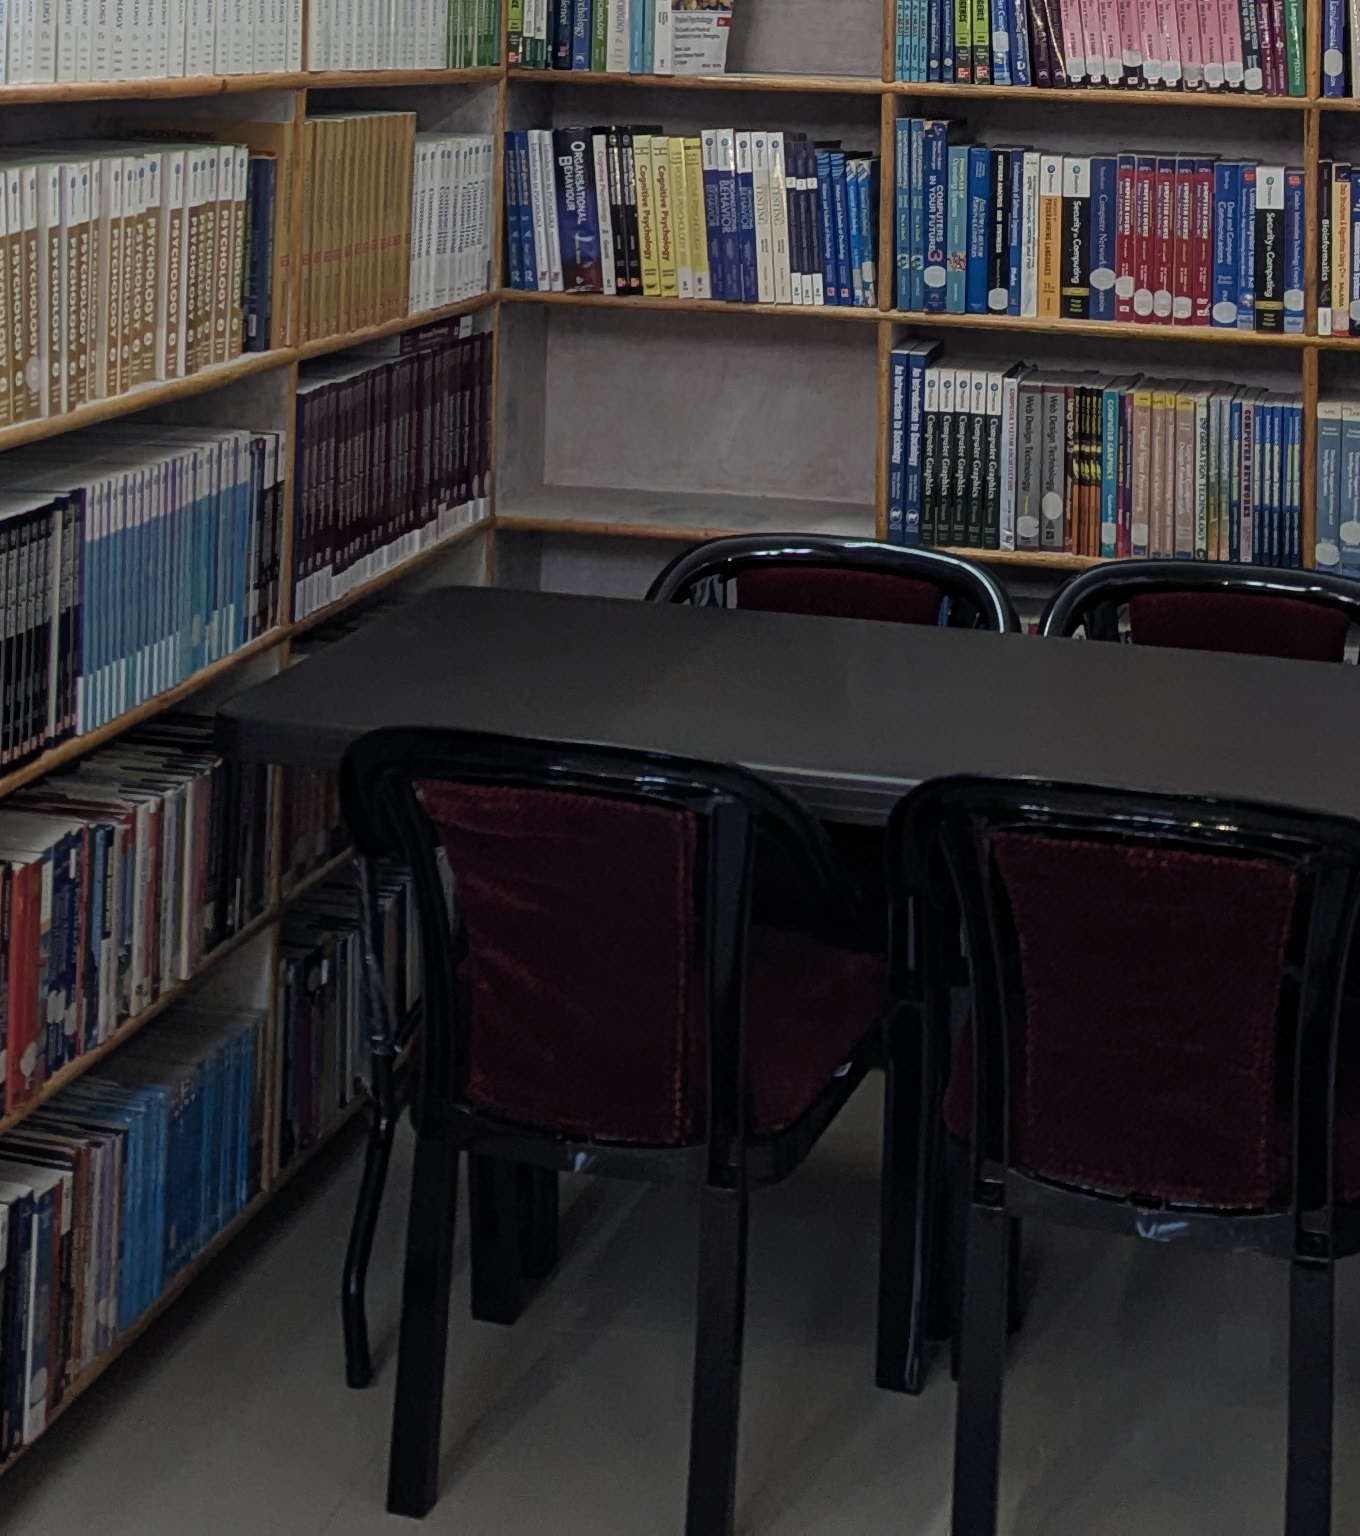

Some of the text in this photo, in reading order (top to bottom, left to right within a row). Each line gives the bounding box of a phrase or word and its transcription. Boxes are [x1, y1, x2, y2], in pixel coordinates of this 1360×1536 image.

[558, 156, 575, 211] BEHAVIOUR
[571, 141, 587, 224] ORGANISATIONAL
[638, 164, 657, 260] Cognitive Psychology
[657, 165, 676, 261] Cognitive Psychology
[719, 180, 732, 233] BEHAVIOR
[936, 184, 944, 242] COMPUTERS
[144, 218, 156, 323] PSYCHOLOGY
[218, 210, 229, 310] PSYCHOLOGY
[928, 214, 936, 250] FUTURE
[928, 249, 943, 262] 3
[1071, 200, 1081, 284] Security Computing
[1265, 213, 1275, 297] Security Computing
[1321, 219, 1329, 281] Bioinformatics
[923, 415, 936, 495] Computer Graphics
[986, 419, 998, 499] Computer Graphics
[1022, 446, 1033, 491] Technology
[1023, 416, 1033, 443] Design
[1046, 396, 1057, 491] Web Design Technology
